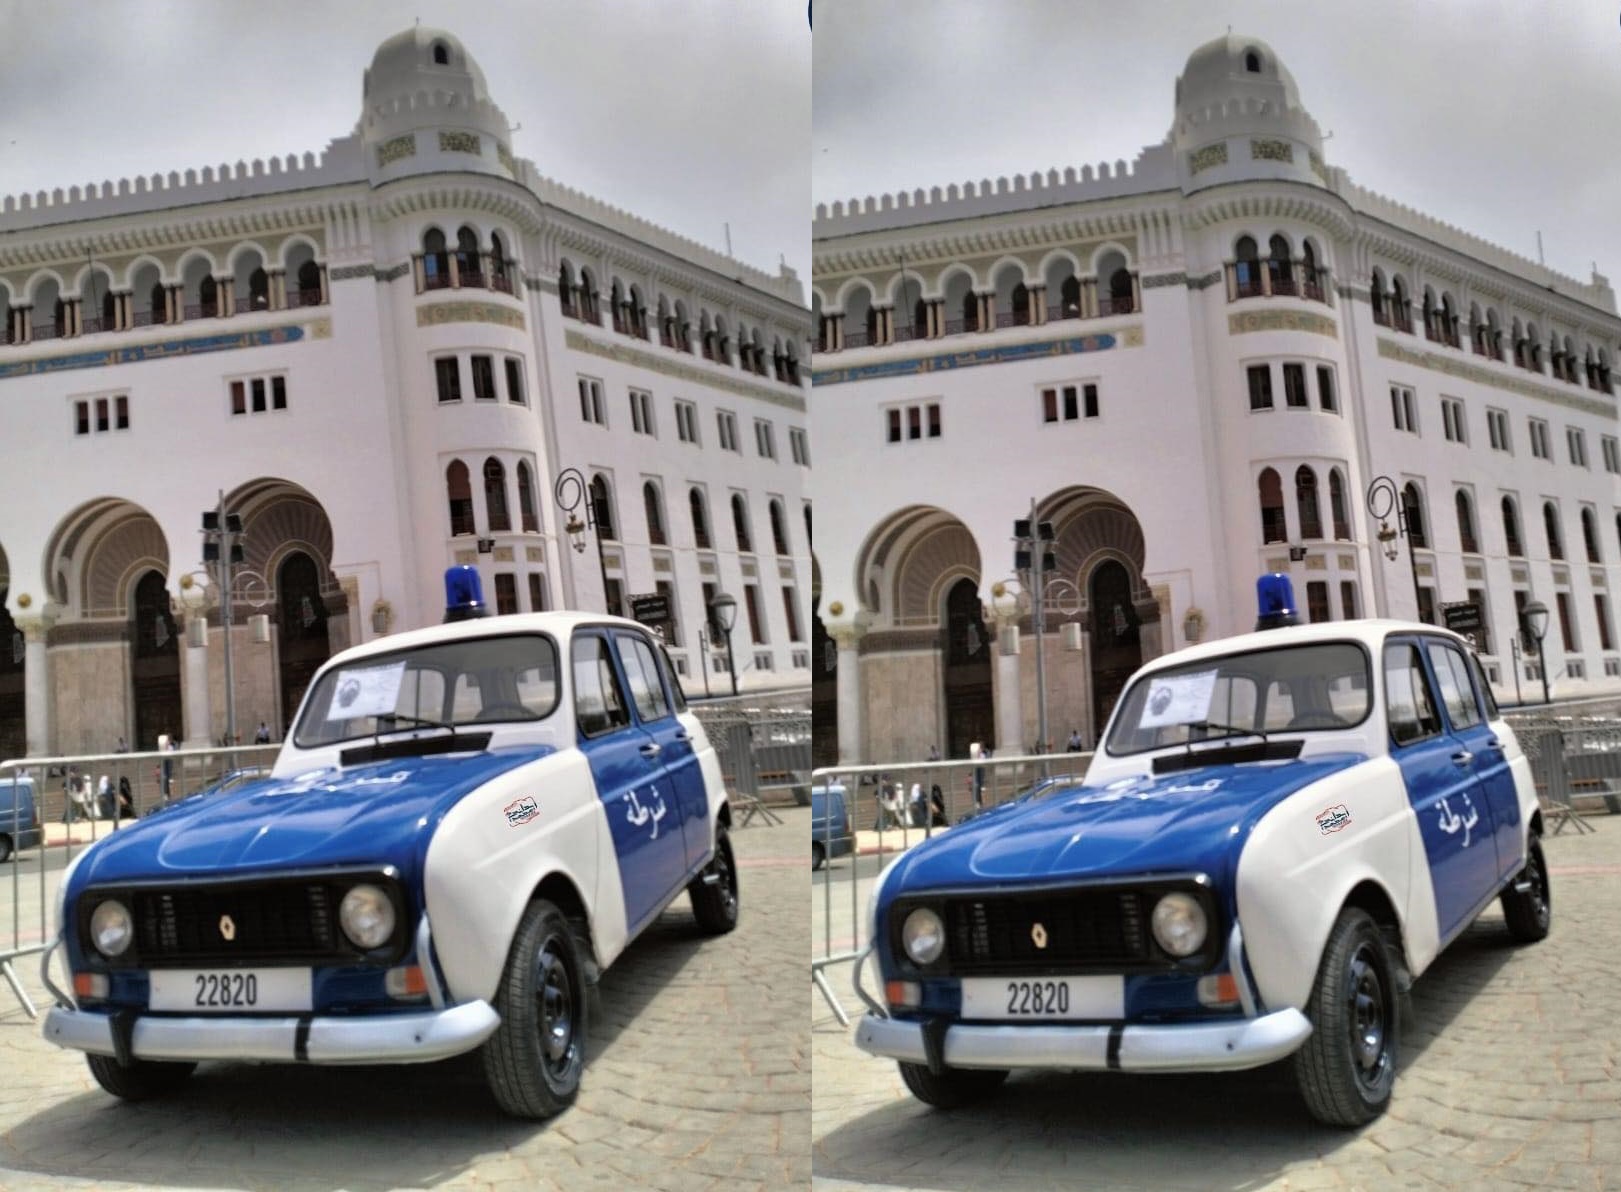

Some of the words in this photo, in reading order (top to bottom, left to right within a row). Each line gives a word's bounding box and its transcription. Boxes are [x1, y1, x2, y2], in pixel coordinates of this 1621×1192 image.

[623, 784, 667, 840] شرطة
[1435, 792, 1479, 848] شرطة
[195, 973, 258, 1007] 22820
[1007, 981, 1070, 1015] 22820
